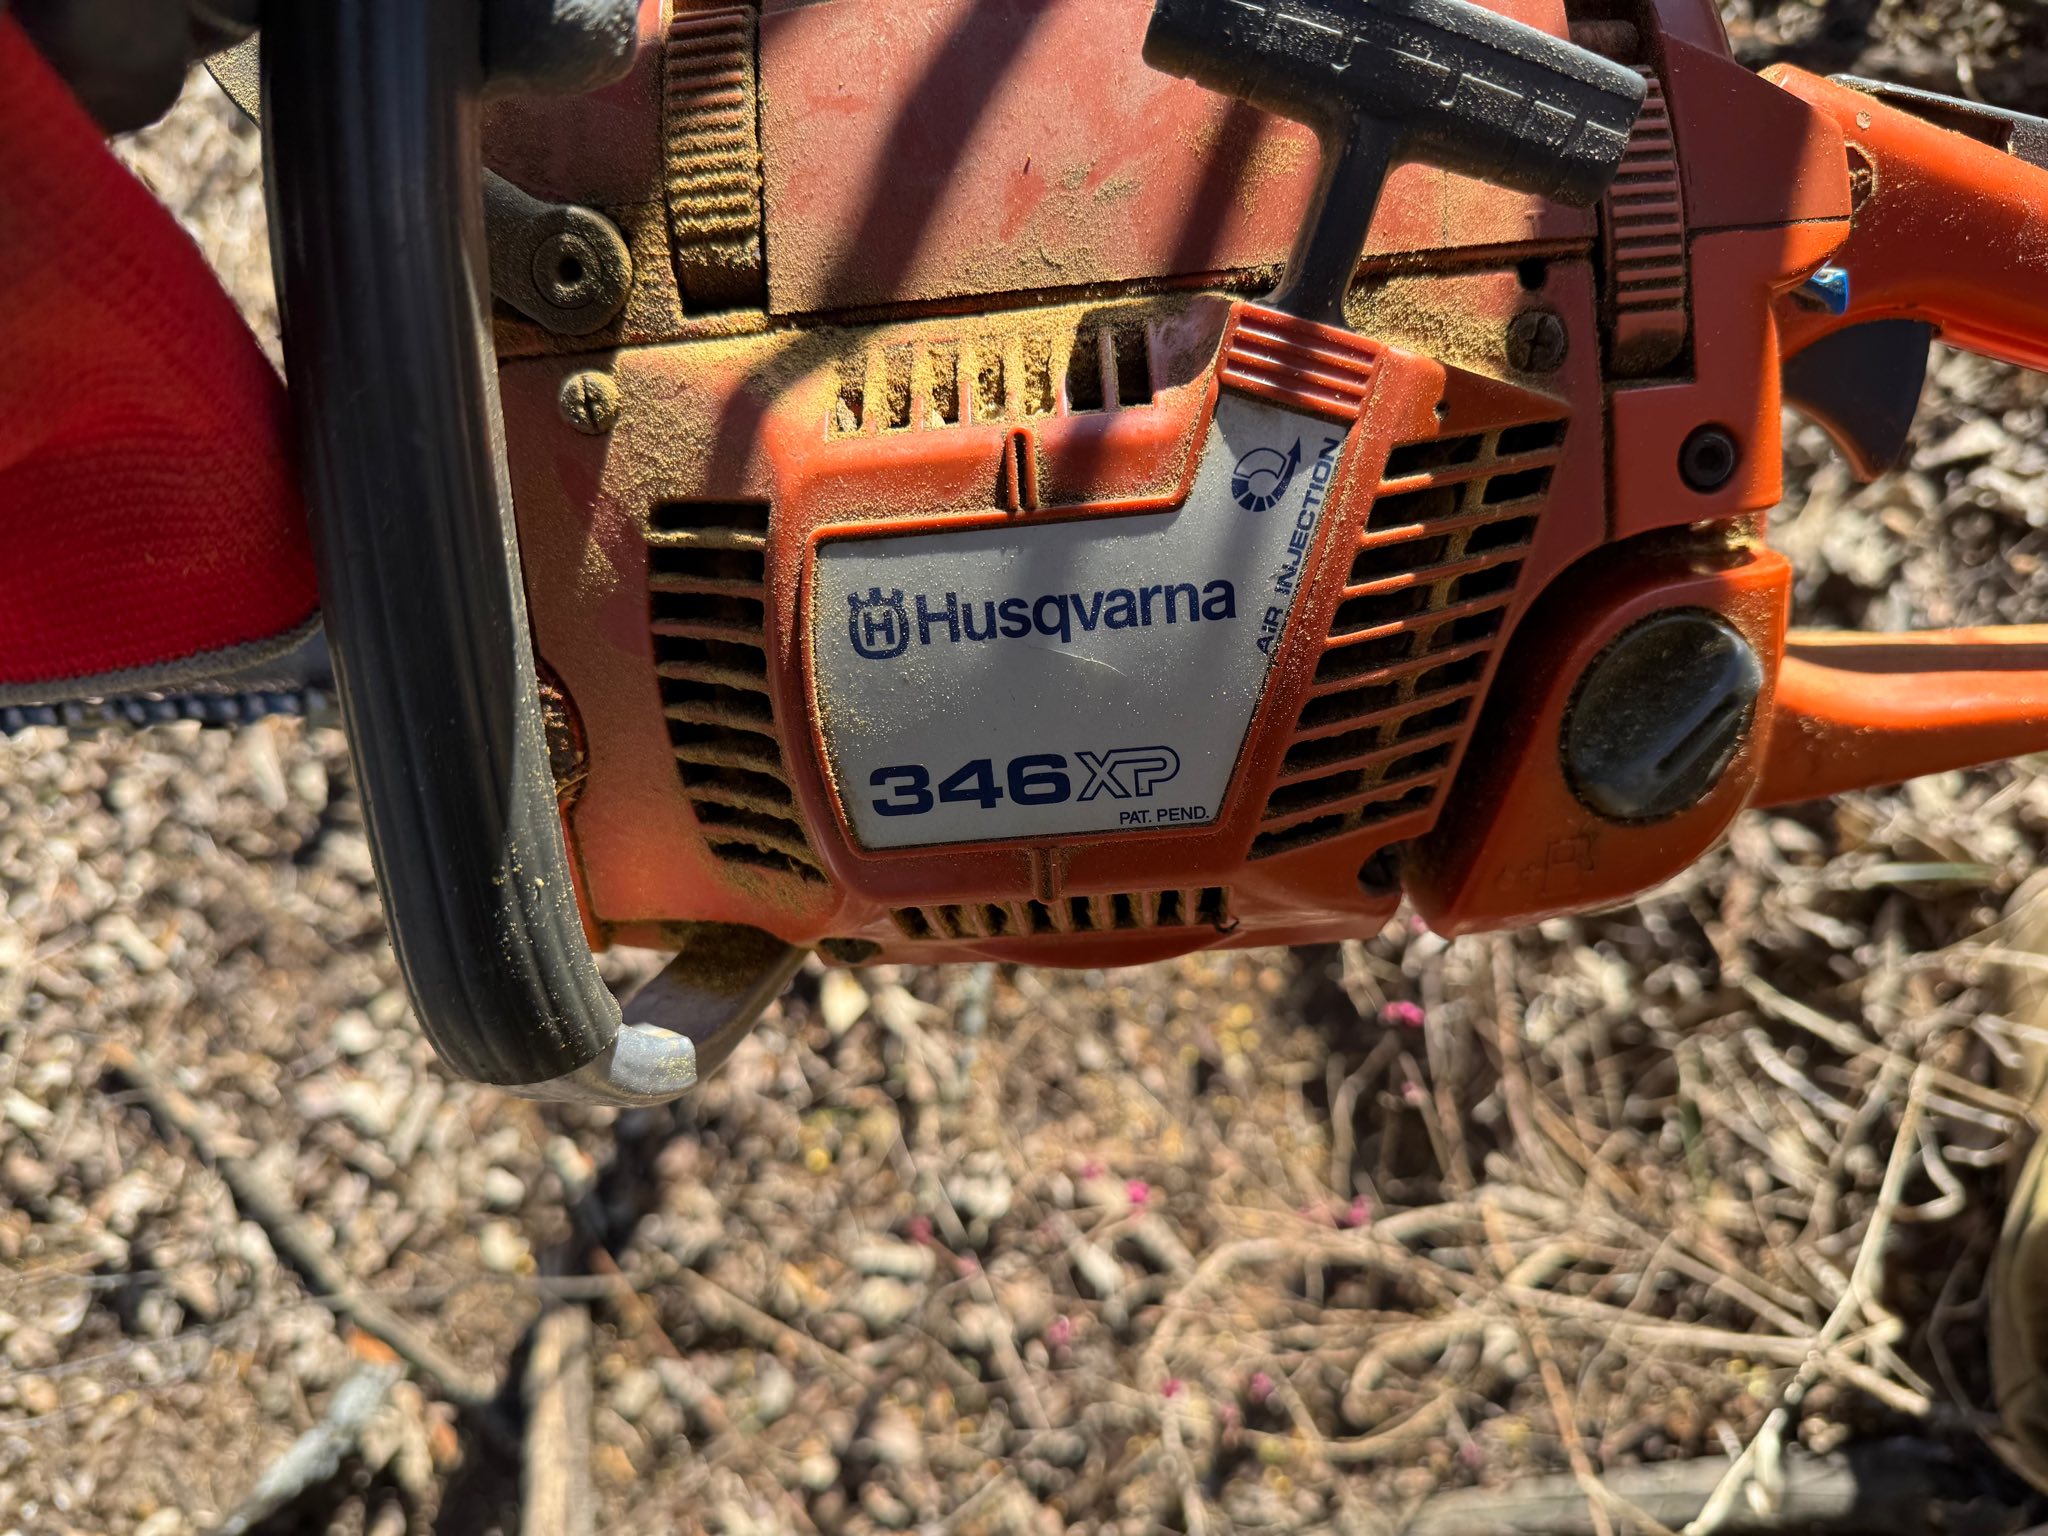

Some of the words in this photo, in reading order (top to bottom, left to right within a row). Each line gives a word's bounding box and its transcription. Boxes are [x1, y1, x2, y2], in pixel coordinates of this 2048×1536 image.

[1256, 606, 1283, 655] AIR
[1276, 437, 1339, 595] INJECTION
[915, 579, 1236, 644] Husqvarna
[1120, 810, 1152, 824] PAT.
[1157, 806, 1210, 822] PEND.
